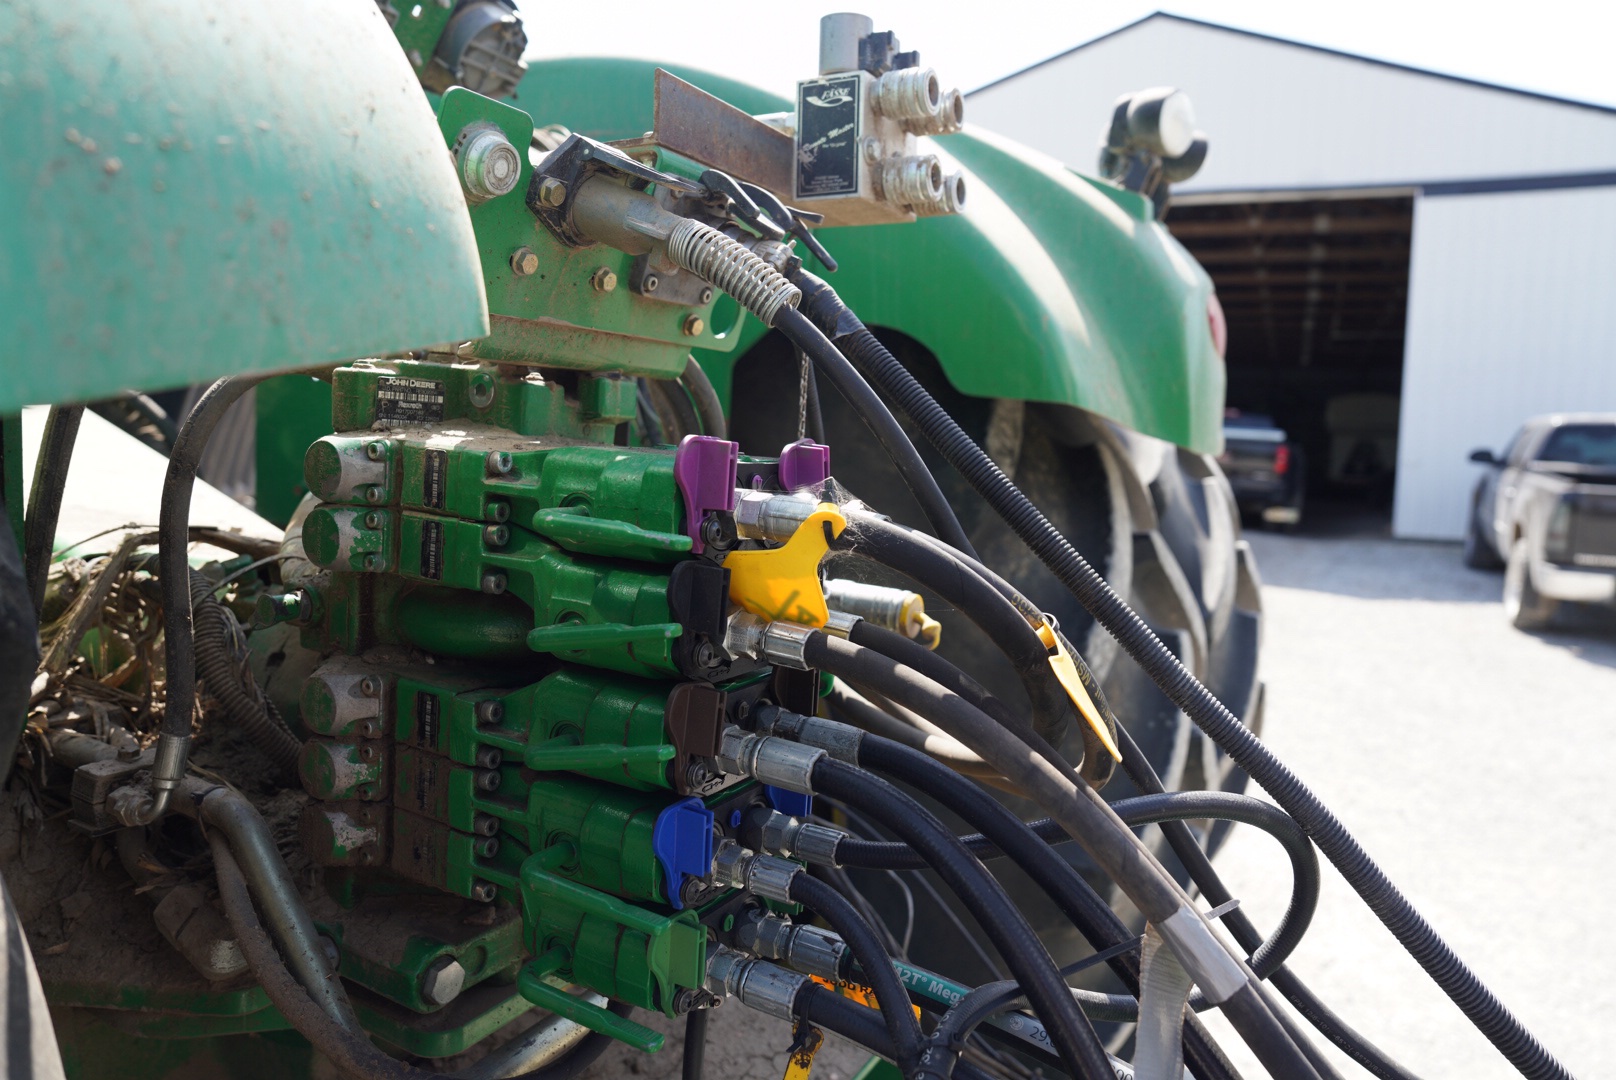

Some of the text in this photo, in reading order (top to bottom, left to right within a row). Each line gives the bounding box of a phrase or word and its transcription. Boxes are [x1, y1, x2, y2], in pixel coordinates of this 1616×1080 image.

[821, 87, 851, 99] FASSE
[386, 378, 436, 389] JOHN DEERE
